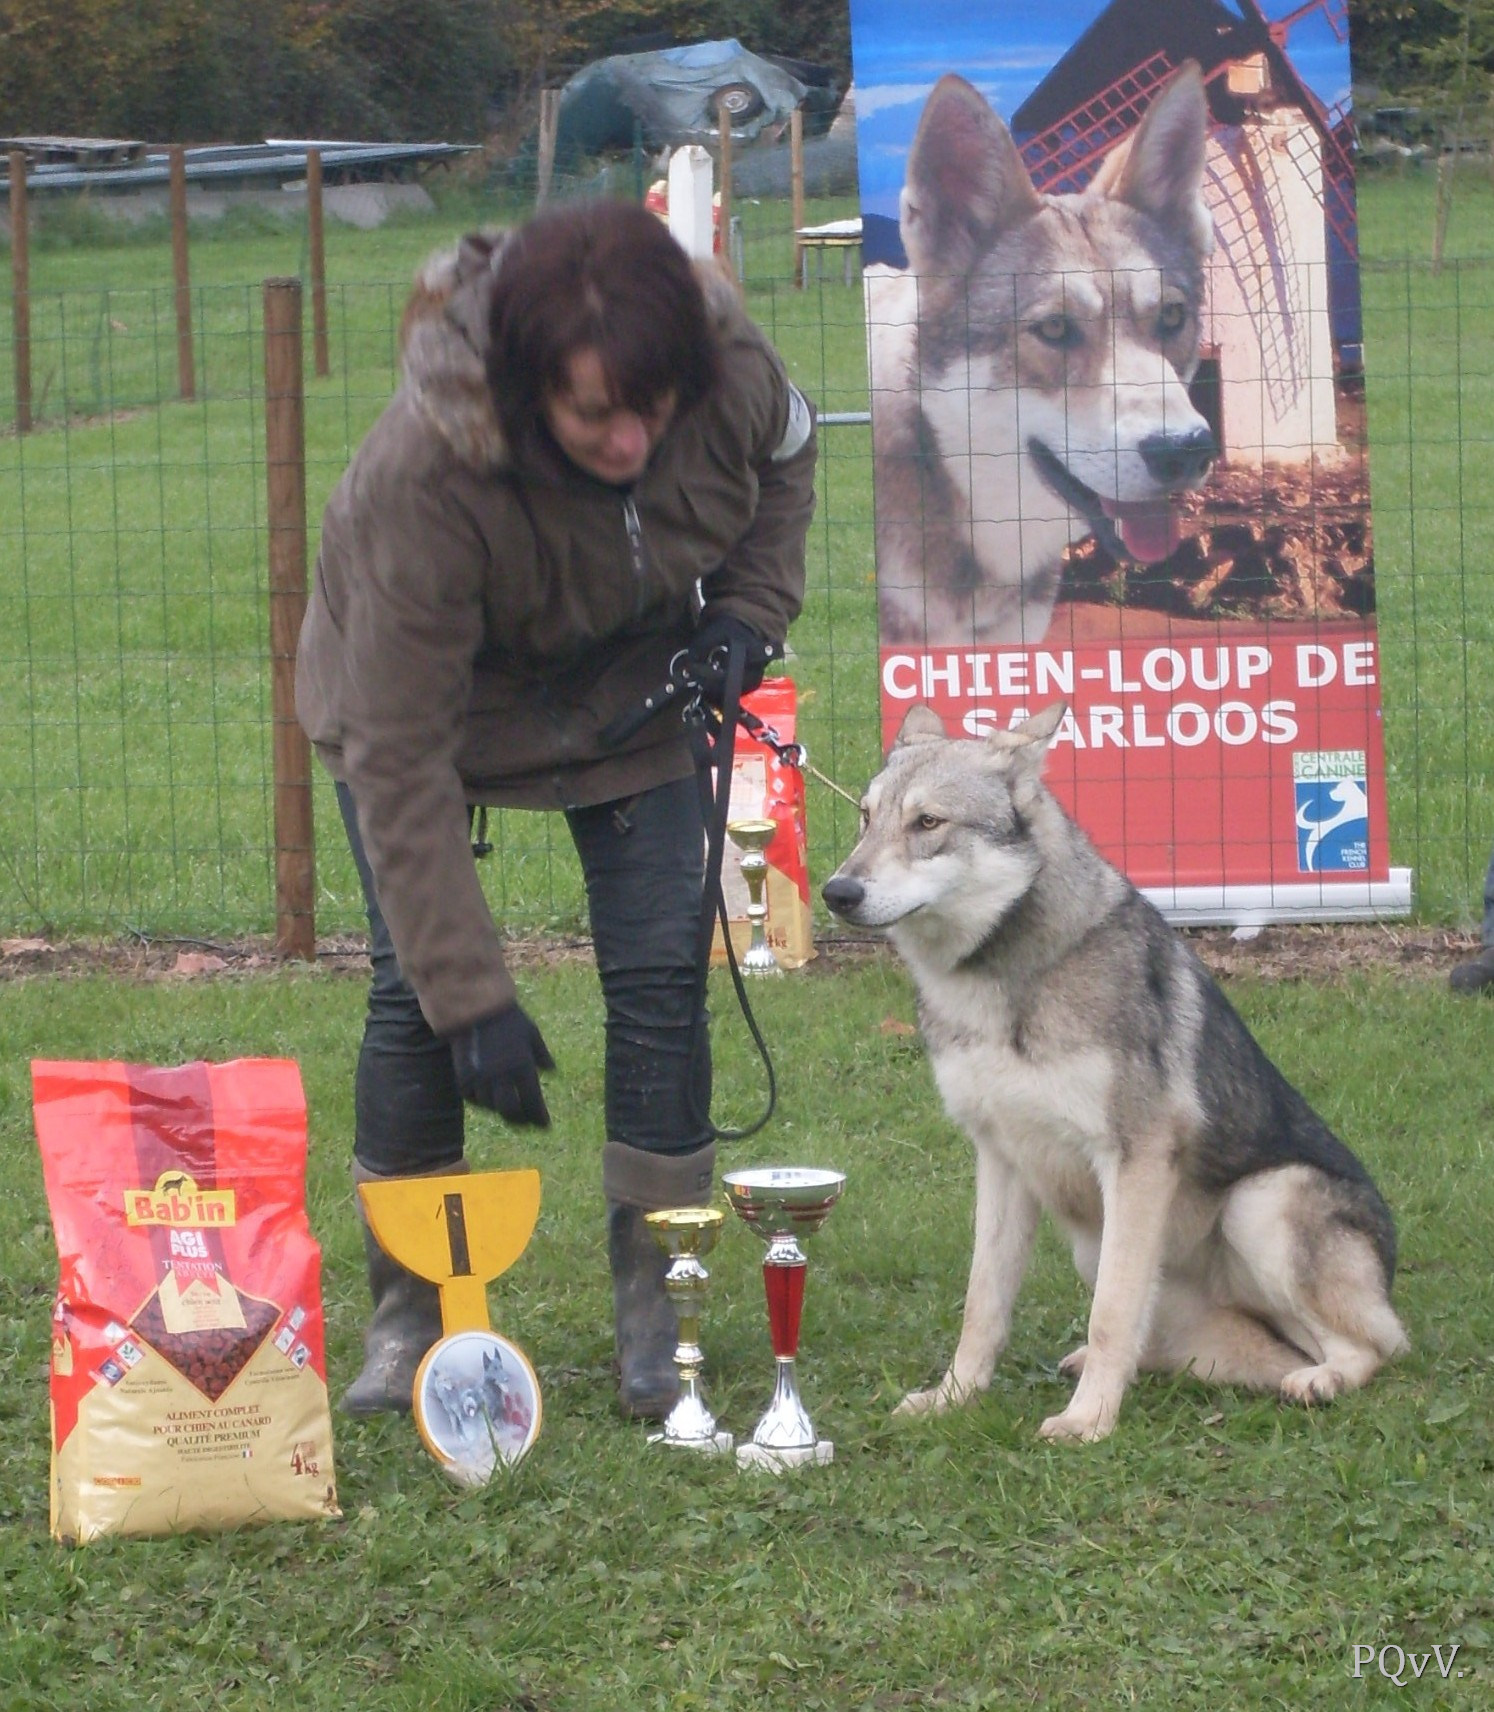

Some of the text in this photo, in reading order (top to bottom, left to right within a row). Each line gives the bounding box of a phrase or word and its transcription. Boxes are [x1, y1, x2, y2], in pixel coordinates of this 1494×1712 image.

[882, 642, 1376, 699] CHIEN-LOUP DE
[1300, 752, 1364, 763] CENTRALE
[1302, 764, 1365, 777] CANINE
[134, 1195, 226, 1221] Bab'in
[170, 1229, 204, 1246] AGI
[171, 1243, 208, 1258] PLUS
[166, 1404, 260, 1421] ALIMENT COMPLET
[153, 1416, 272, 1435] POUR CHIEN AU CANARD
